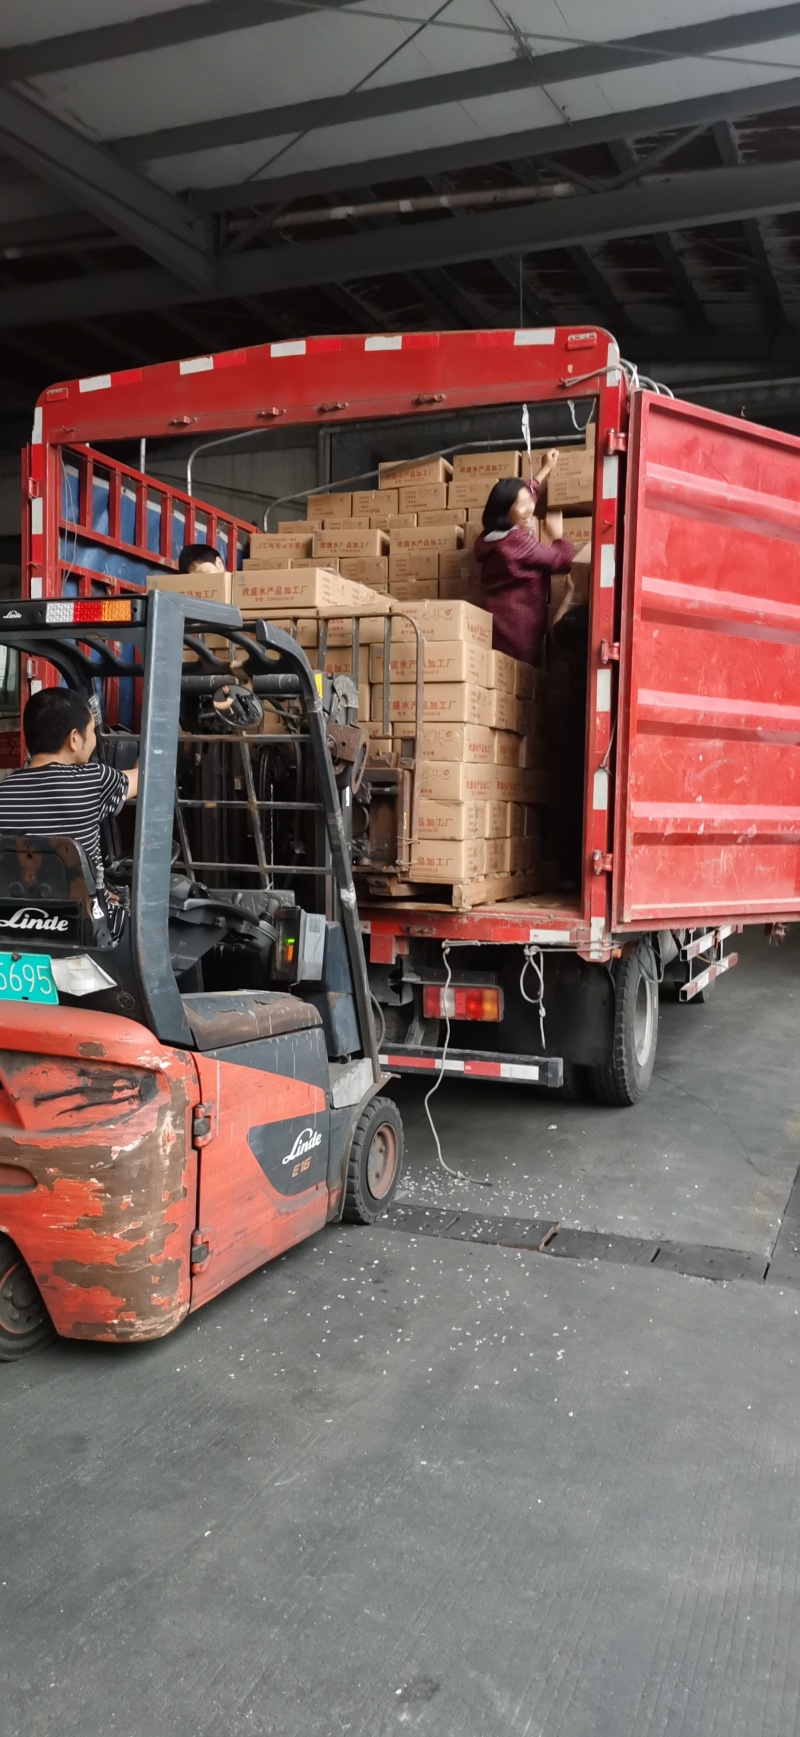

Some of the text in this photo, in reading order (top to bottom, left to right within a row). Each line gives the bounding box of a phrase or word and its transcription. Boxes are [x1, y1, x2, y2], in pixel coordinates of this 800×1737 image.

[242, 585, 309, 596] 欣盛水产品加工厂
[3, 610, 22, 619] Linde
[381, 659, 455, 670] 盛水产加工厂
[391, 700, 456, 710] 盛水产品加工厂
[0, 907, 68, 931] Linde
[282, 1127, 322, 1165] Linde
